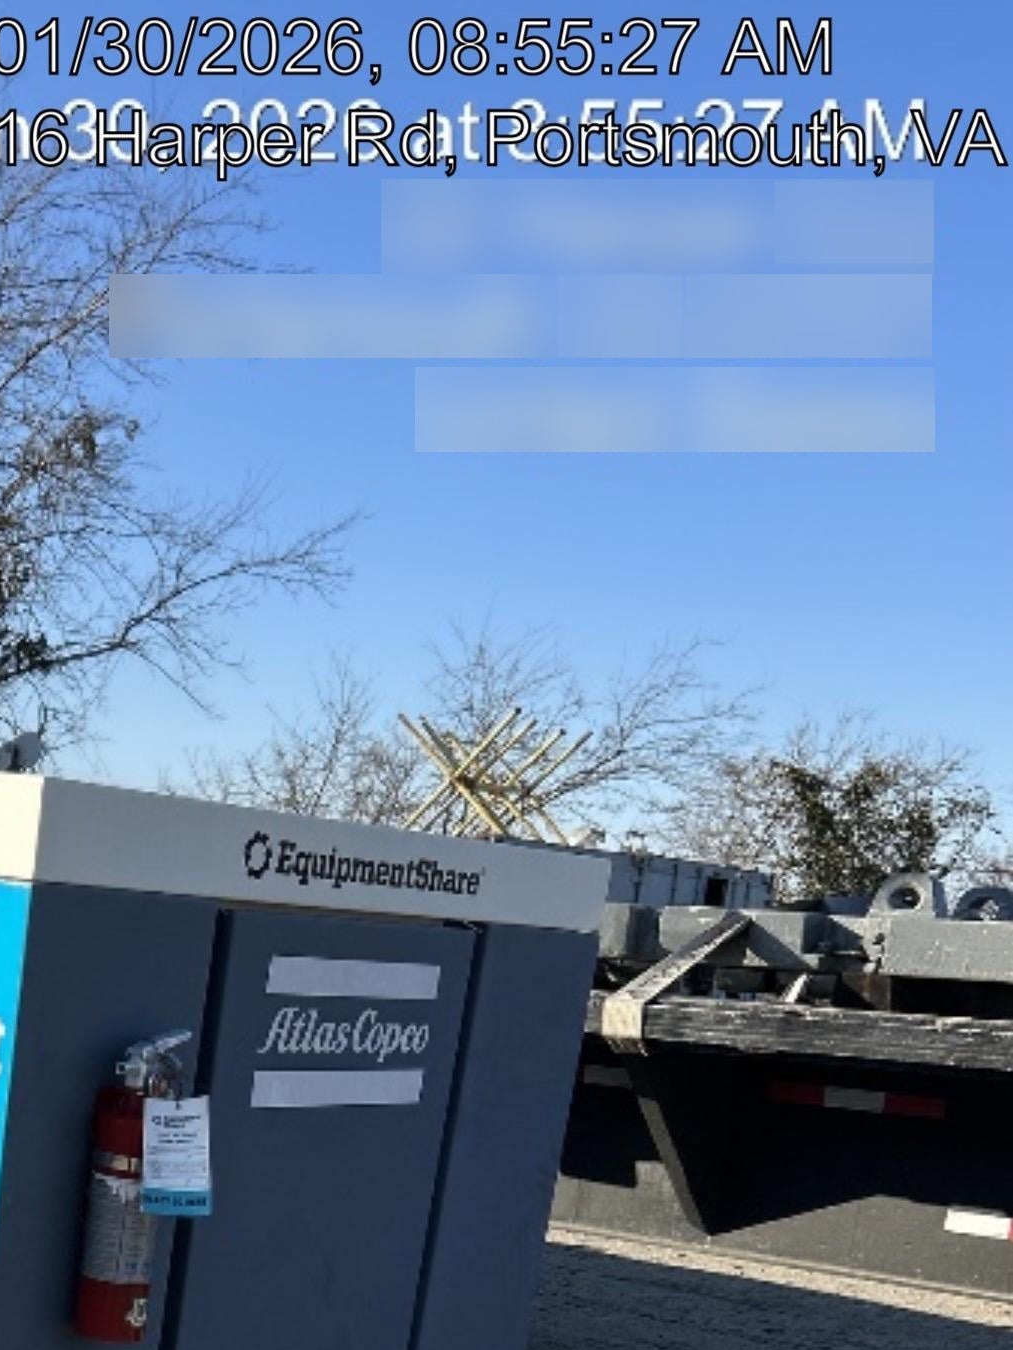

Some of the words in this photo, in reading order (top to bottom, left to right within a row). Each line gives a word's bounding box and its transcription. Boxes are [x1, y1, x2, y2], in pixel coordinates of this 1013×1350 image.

[276, 840, 481, 895] EquipmentShare
[257, 1007, 352, 1054] Atlas
[353, 1008, 430, 1063] Copco
